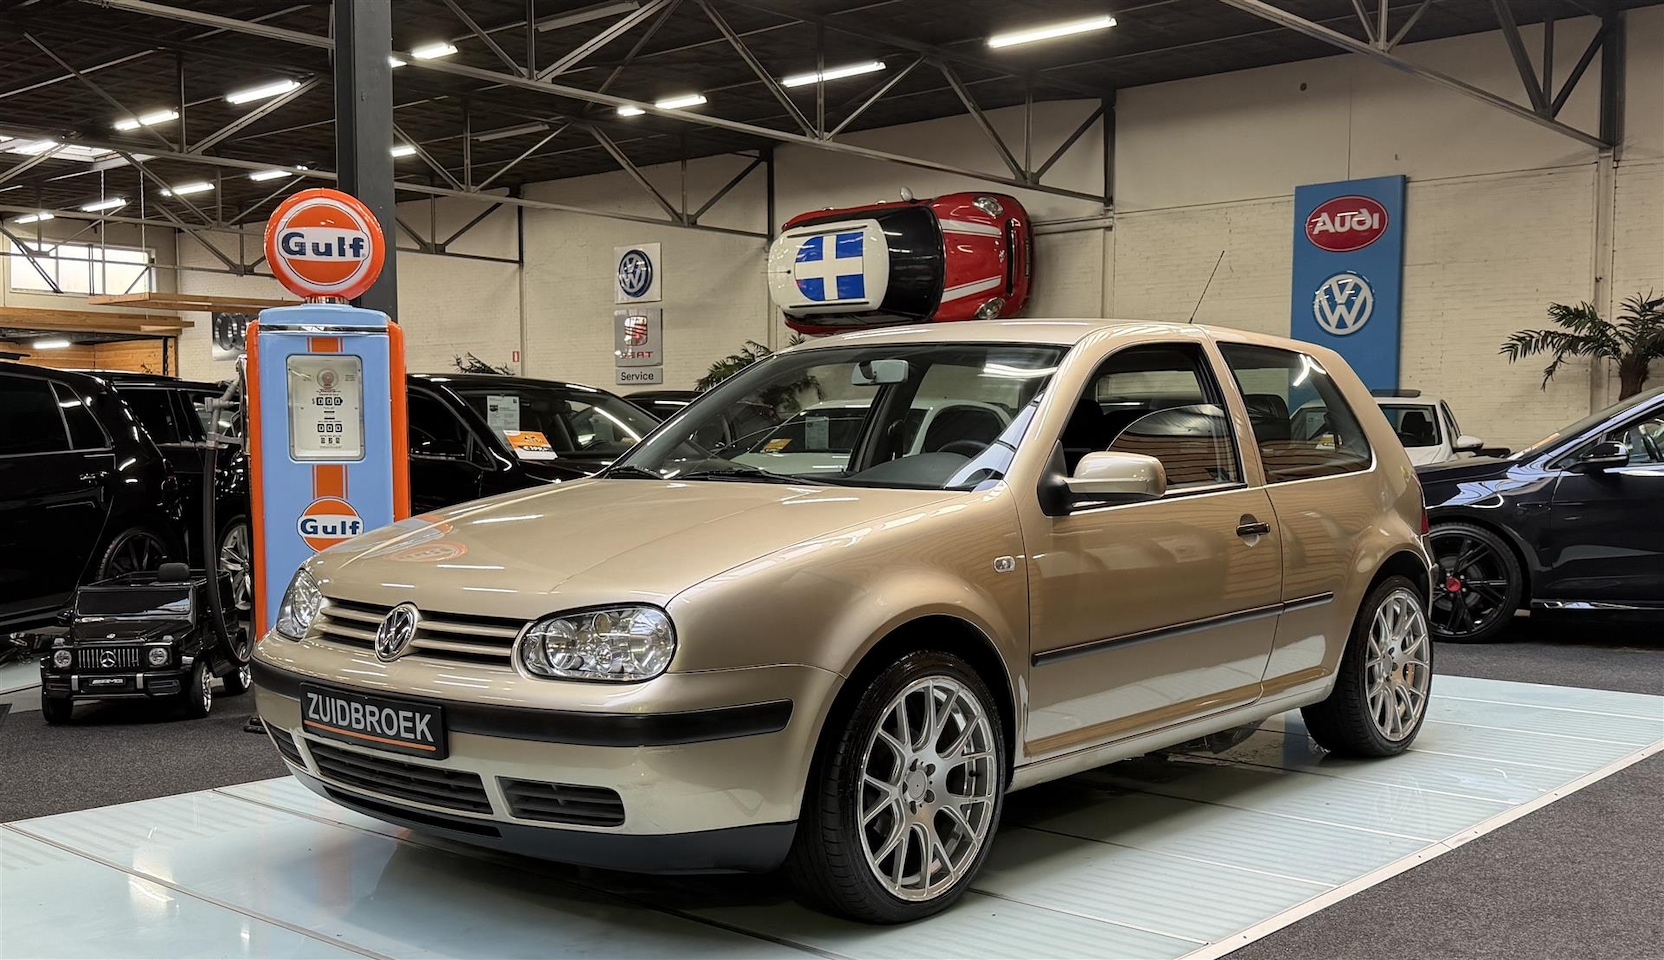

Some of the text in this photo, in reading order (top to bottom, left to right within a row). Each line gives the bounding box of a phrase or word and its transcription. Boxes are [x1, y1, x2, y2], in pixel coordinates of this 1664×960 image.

[281, 232, 364, 258] Gulf
[621, 371, 654, 381] Service
[300, 518, 360, 535] Gulf
[306, 692, 434, 742] ZUIDBROEK
